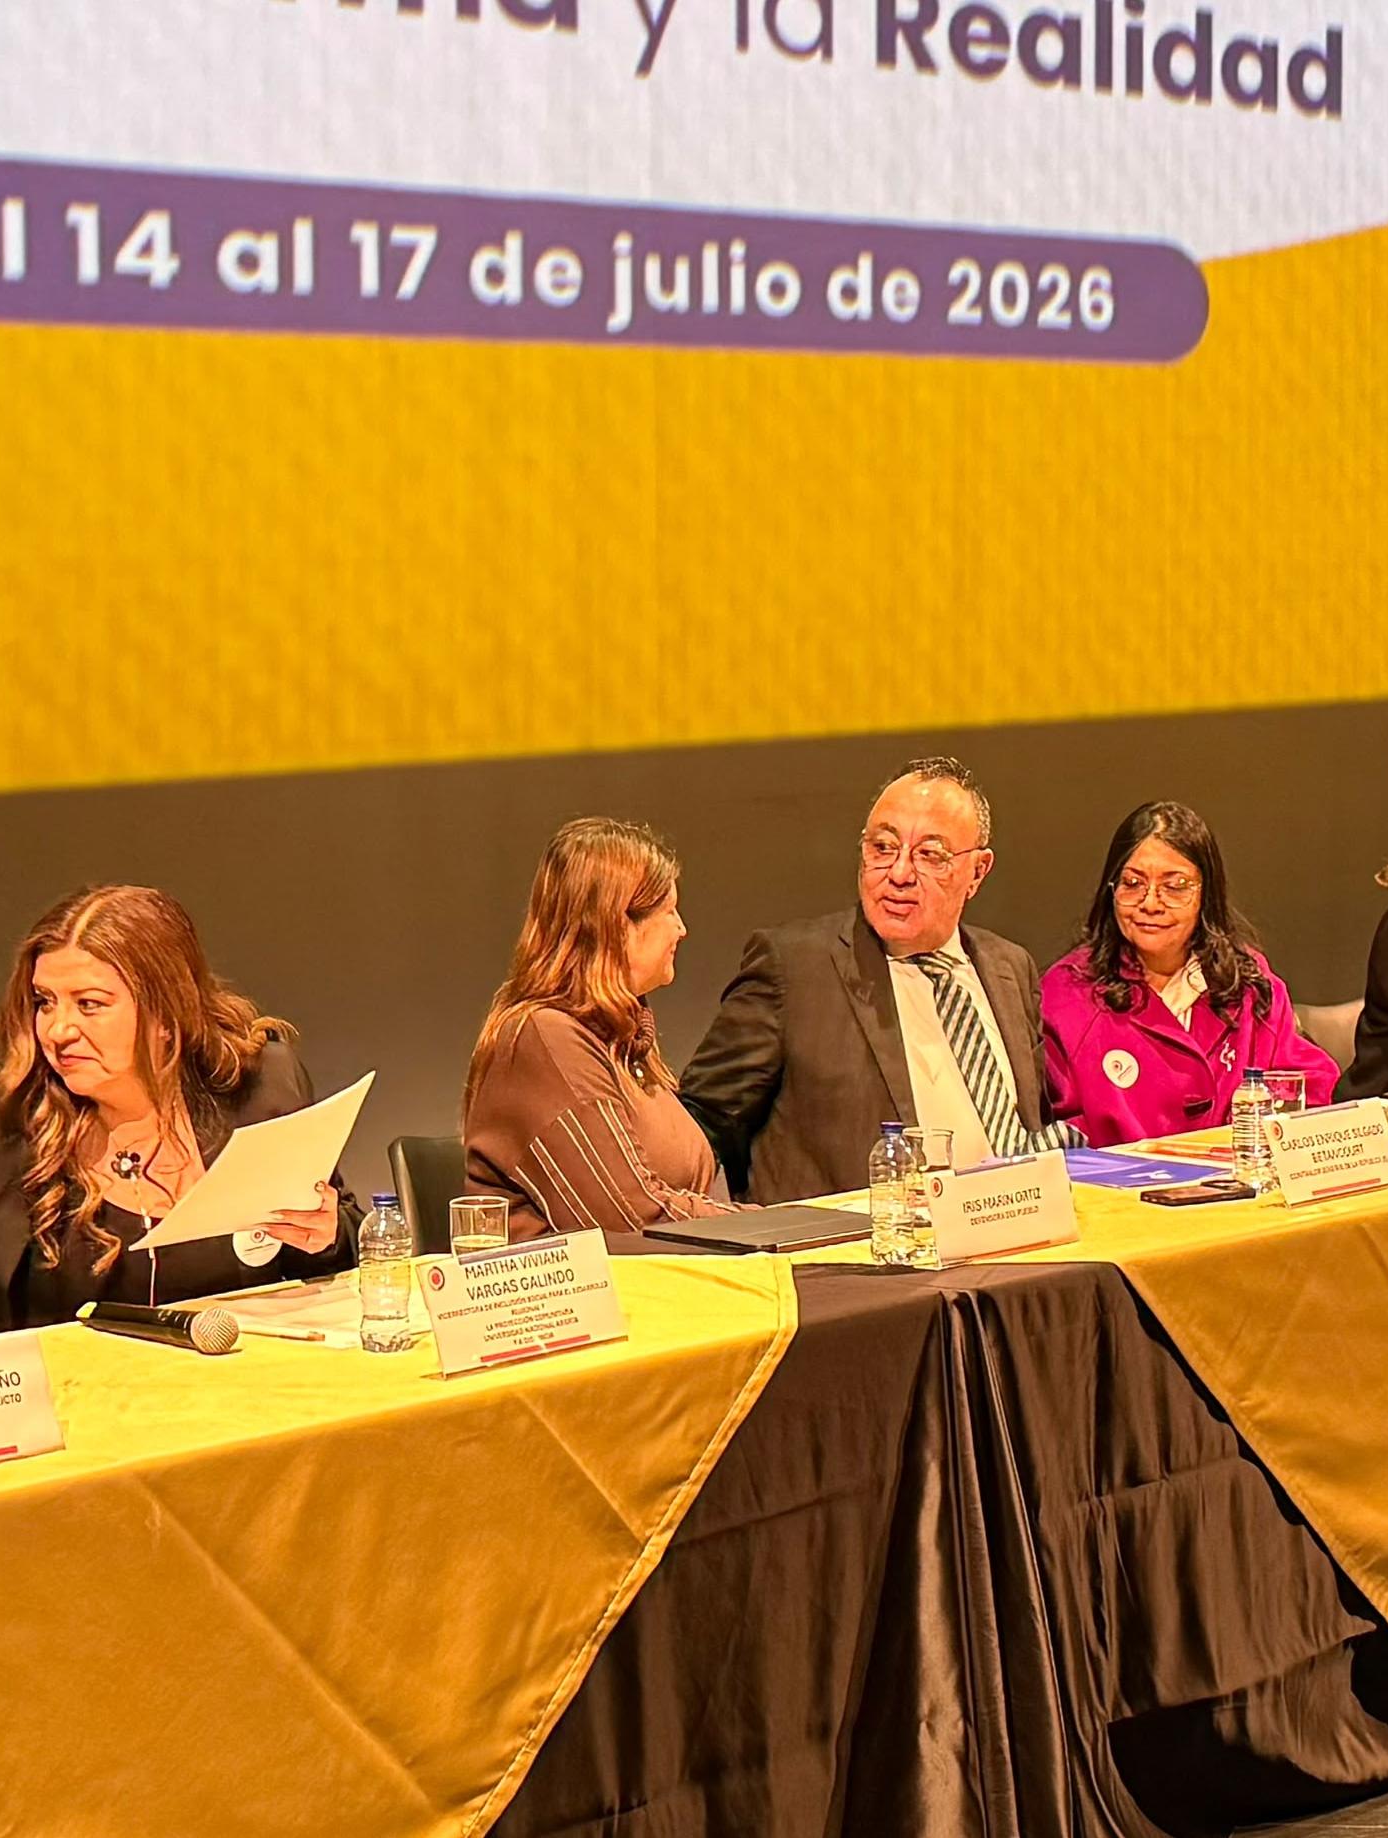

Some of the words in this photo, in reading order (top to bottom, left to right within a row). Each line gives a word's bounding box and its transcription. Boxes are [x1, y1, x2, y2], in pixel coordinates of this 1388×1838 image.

[634, 0, 677, 78] y
[876, 0, 1343, 121] Realidad
[66, 202, 180, 289] 14
[216, 216, 312, 296] al
[349, 219, 438, 300] 17
[469, 229, 583, 308] de
[606, 230, 801, 333] julio
[827, 250, 921, 321] de
[946, 256, 1114, 332] 2026
[963, 1199, 982, 1213] IRIS
[1015, 1187, 1042, 1203] ORTIZ
[464, 1259, 518, 1281] MARTHA
[519, 1249, 569, 1270] VIVIANA
[466, 1279, 519, 1301] VARGAS
[519, 1268, 575, 1291] GALINDO
